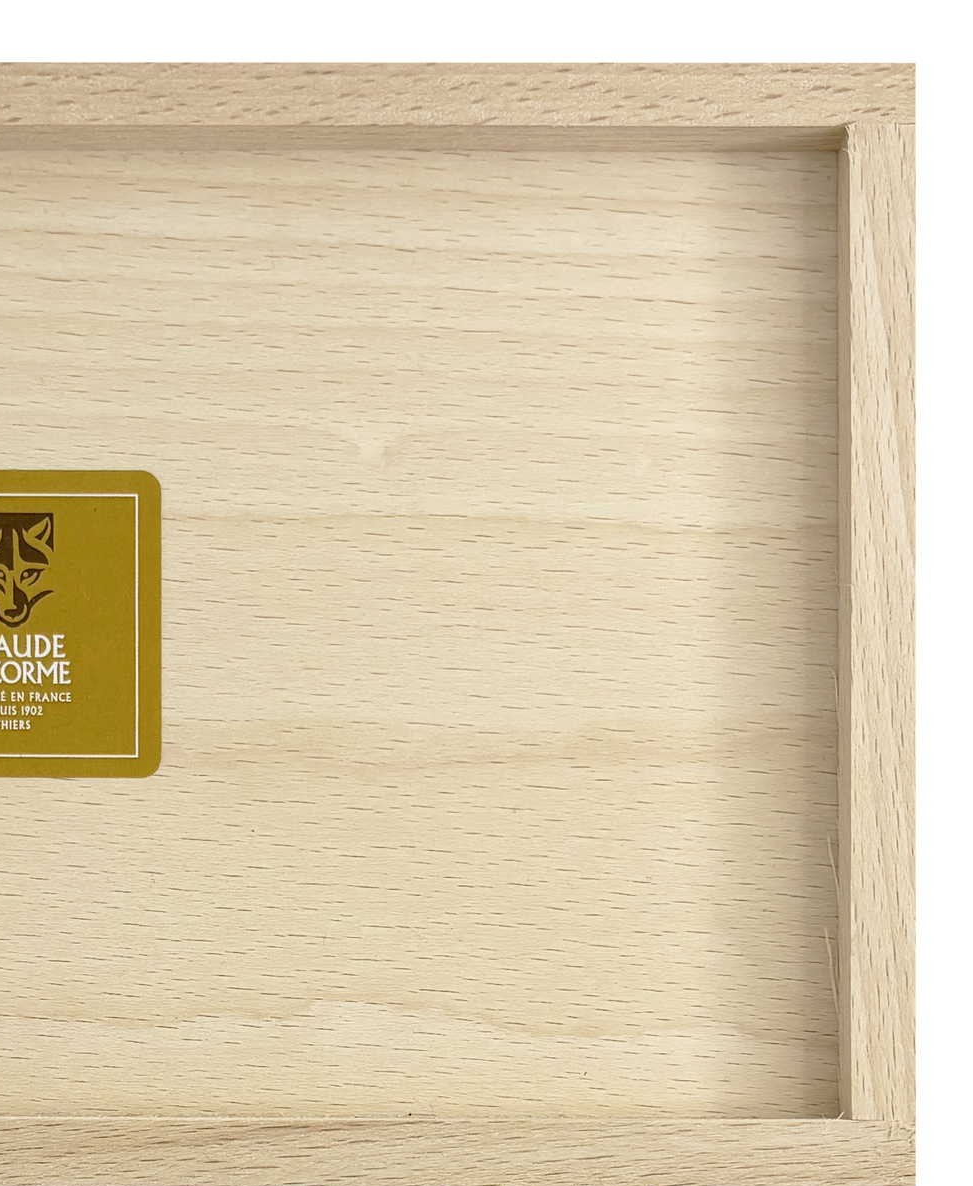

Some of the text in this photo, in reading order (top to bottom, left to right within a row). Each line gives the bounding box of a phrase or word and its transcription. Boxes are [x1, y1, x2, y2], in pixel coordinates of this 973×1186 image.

[11, 691, 25, 703] EN
[29, 692, 72, 703] FRANCE
[21, 705, 44, 716] 1902
